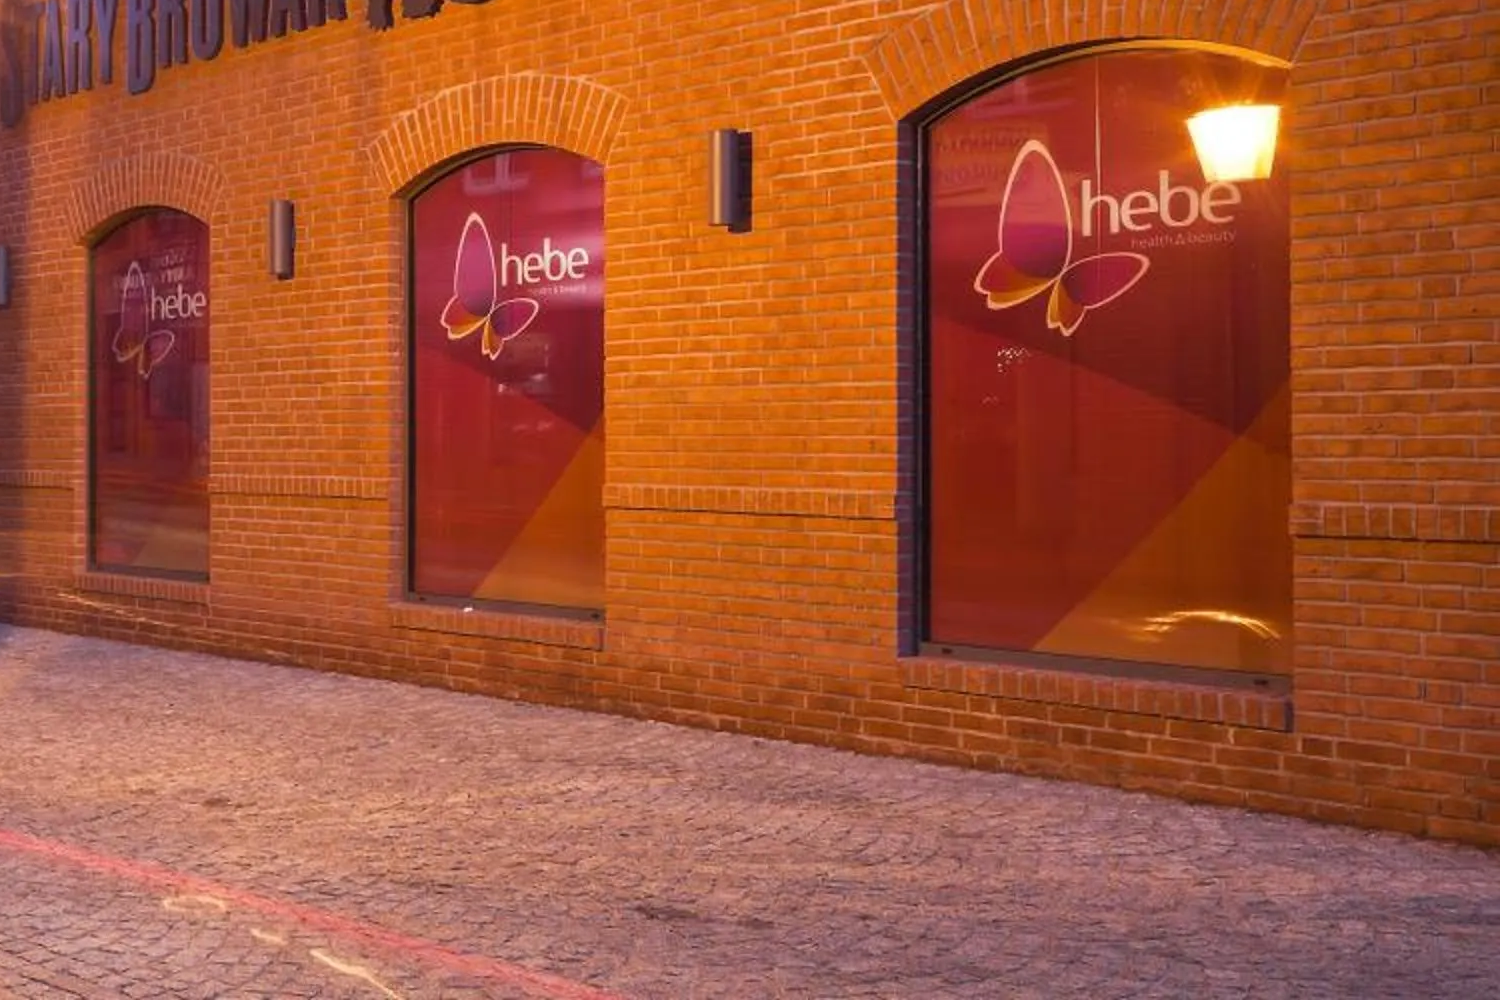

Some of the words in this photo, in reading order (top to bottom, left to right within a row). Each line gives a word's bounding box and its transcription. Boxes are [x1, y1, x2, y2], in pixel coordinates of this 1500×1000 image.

[1081, 169, 1242, 237] hebe
[501, 237, 590, 287] hebe
[151, 283, 208, 321] hebe
